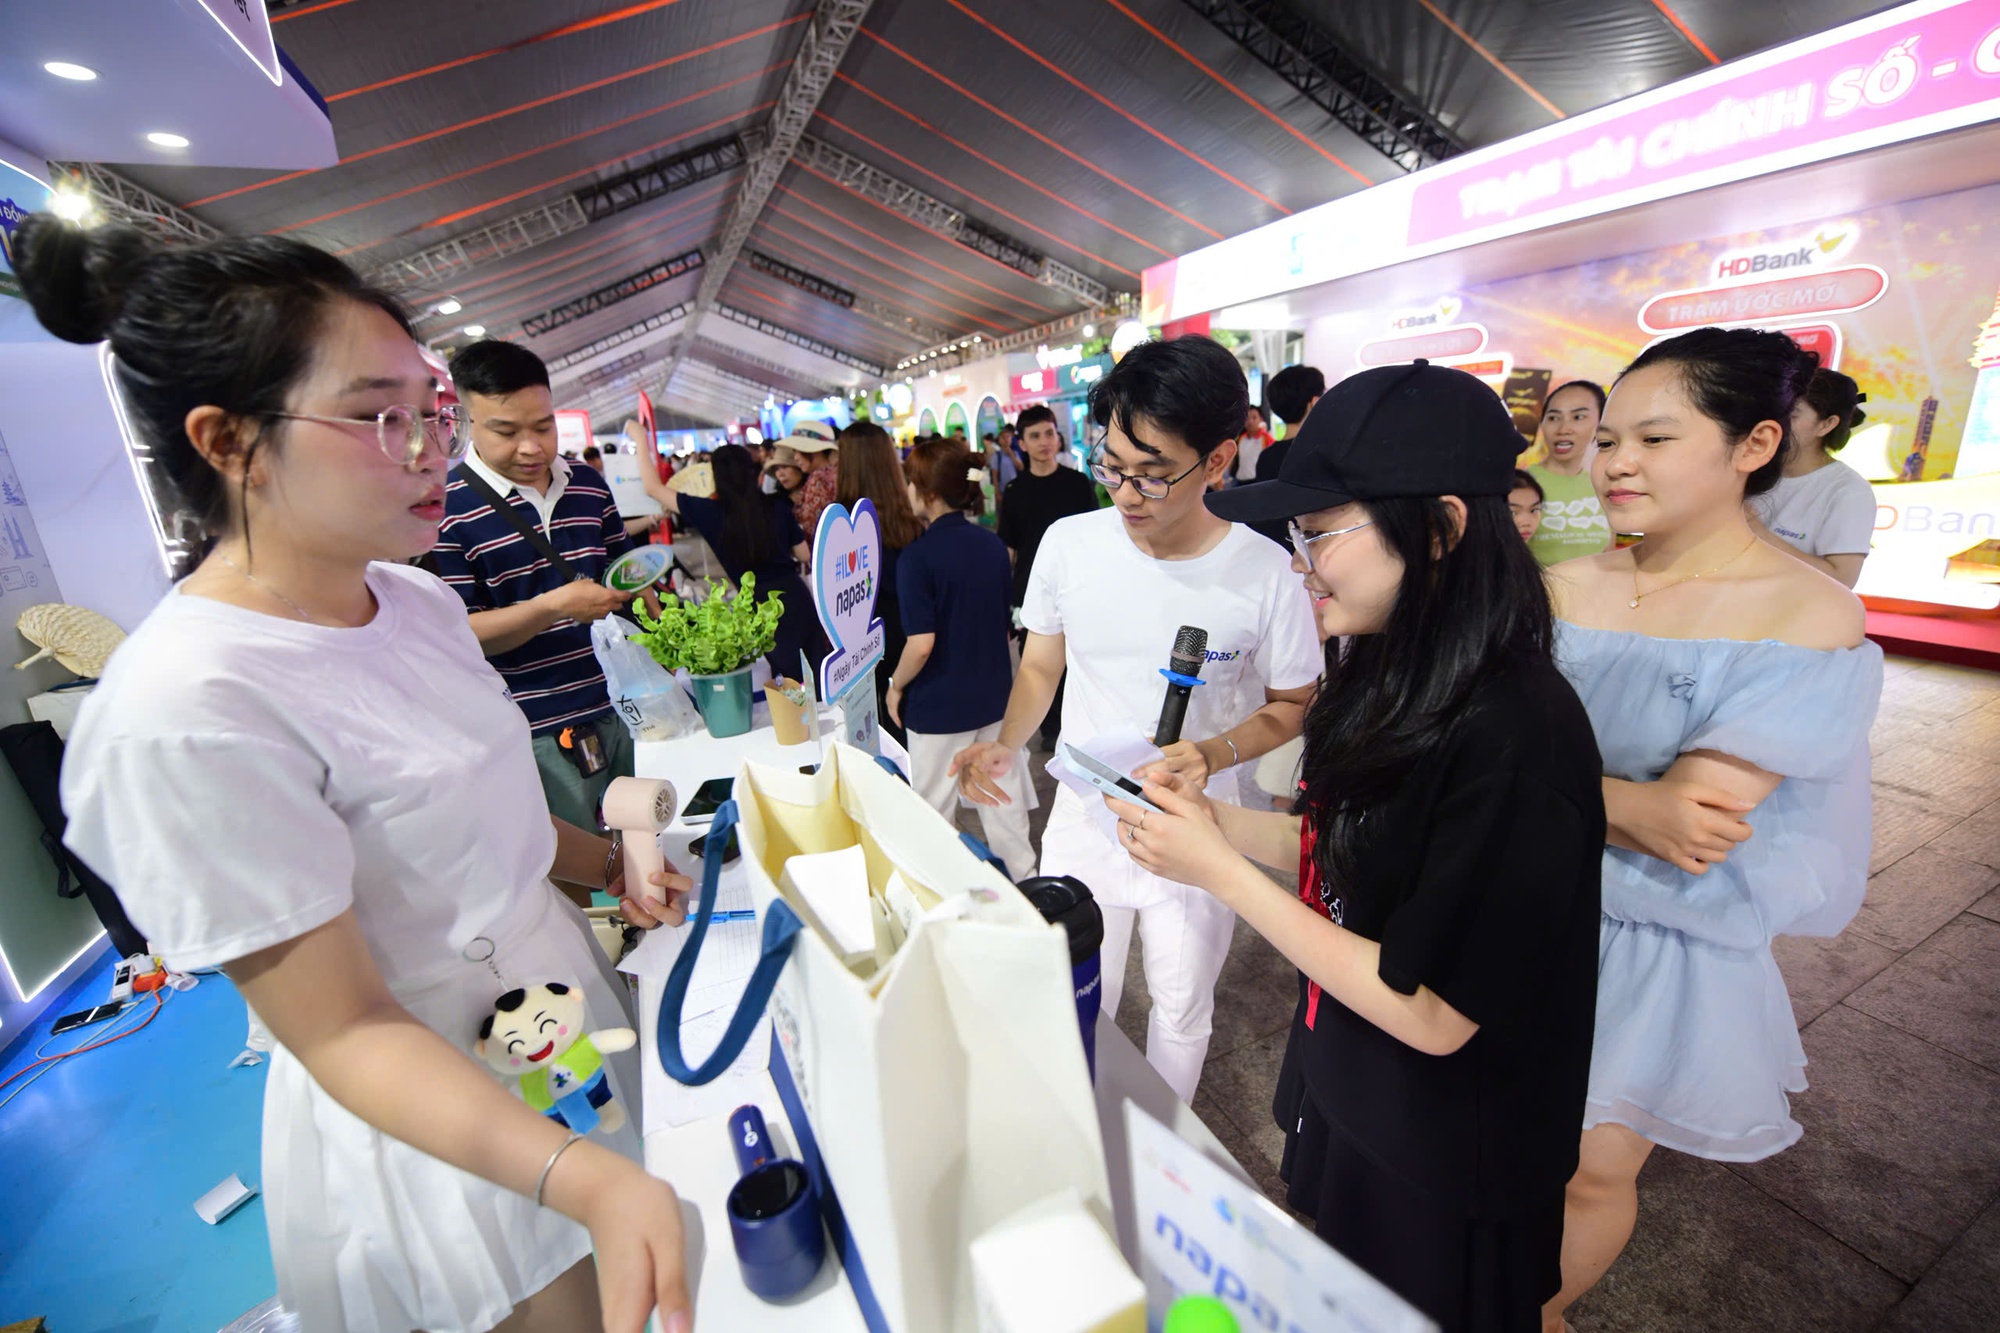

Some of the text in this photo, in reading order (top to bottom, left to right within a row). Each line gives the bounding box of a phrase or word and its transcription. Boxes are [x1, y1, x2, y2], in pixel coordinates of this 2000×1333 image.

[1824, 34, 1922, 119] SỐ
[1718, 248, 1813, 278] HDBank
[1872, 504, 1999, 536] DBan
[836, 579, 865, 617] napas
[1204, 649, 1232, 663] apas
[1155, 1213, 1308, 1333] napa
